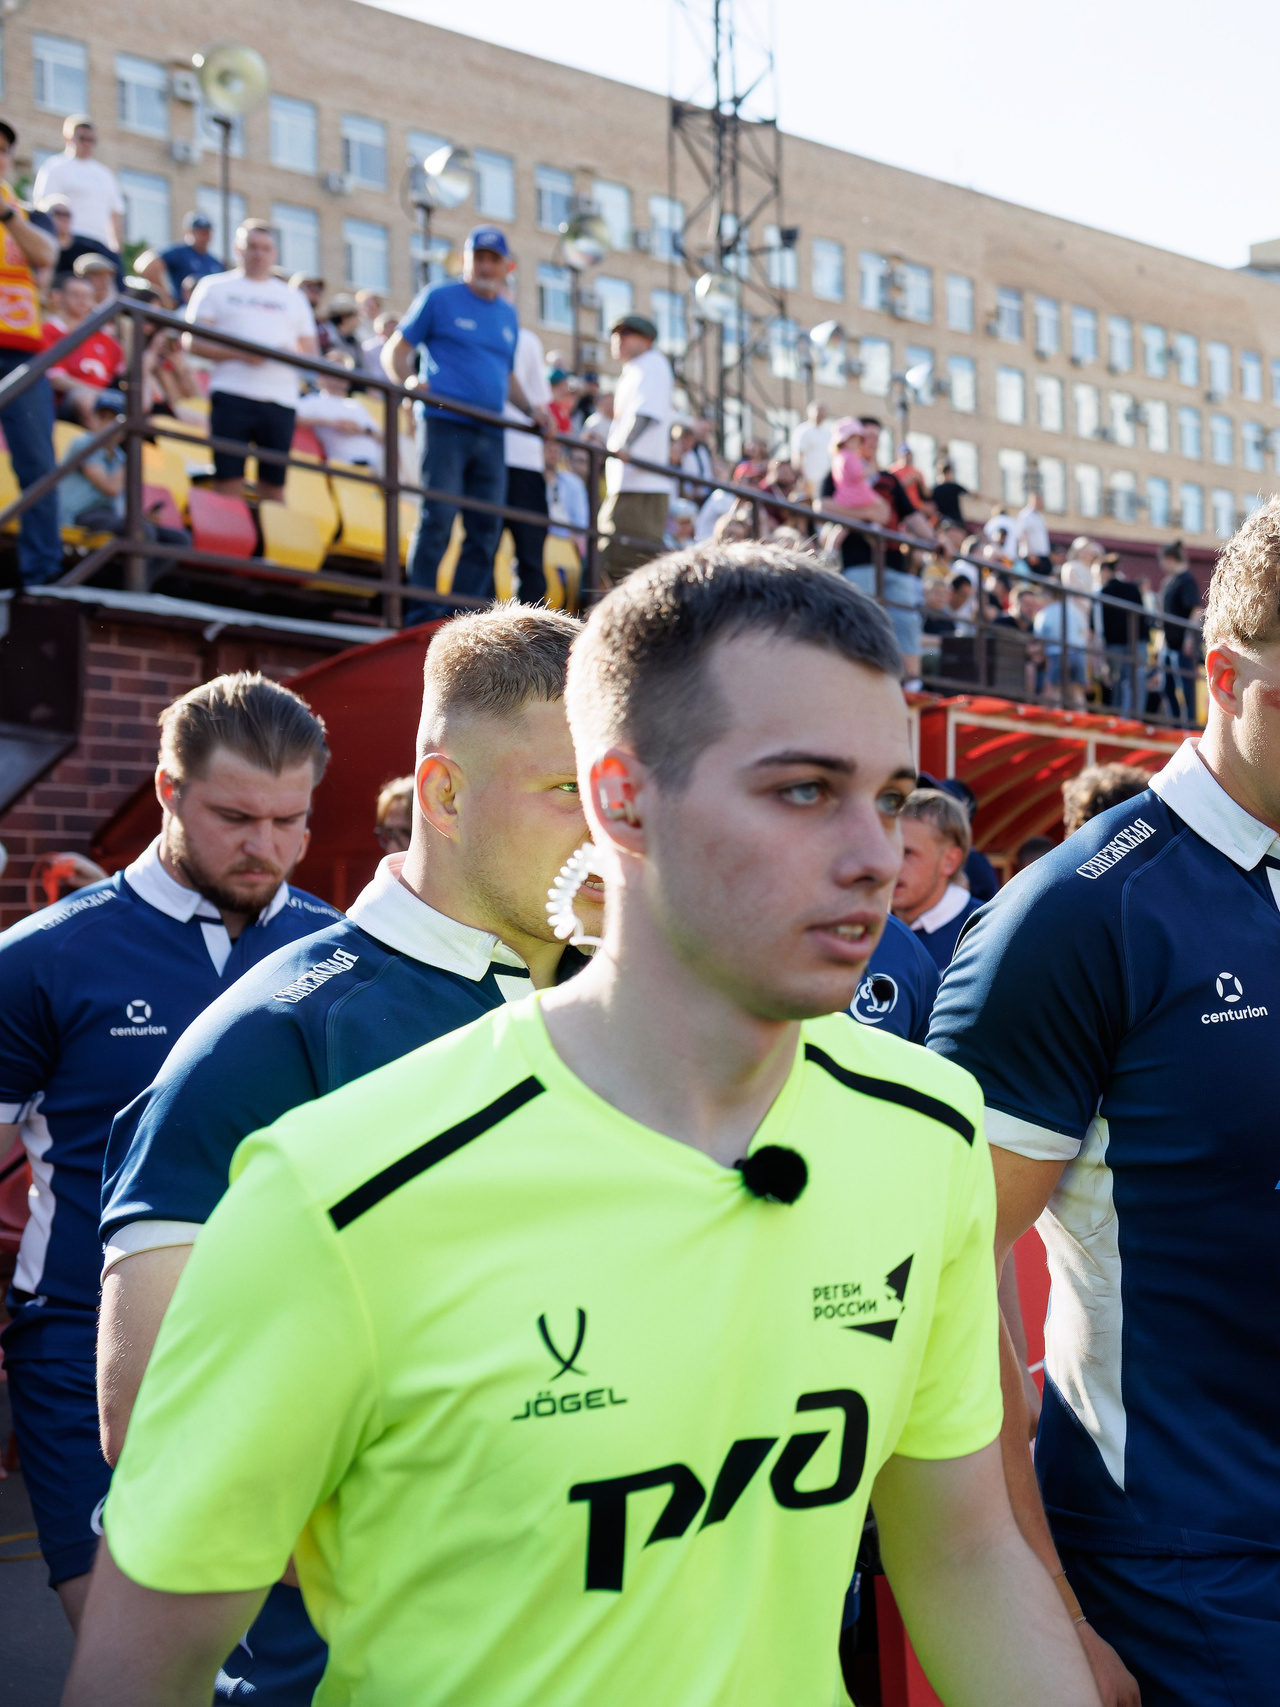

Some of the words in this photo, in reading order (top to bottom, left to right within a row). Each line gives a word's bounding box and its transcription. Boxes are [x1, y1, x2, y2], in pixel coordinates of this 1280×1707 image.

[1075, 817, 1157, 880] СЕНЕЖСКАЯ
[1201, 1004, 1269, 1025] centurion
[110, 1025, 168, 1038] centurion
[812, 1283, 863, 1302] РЕГБИ
[812, 1299, 878, 1321] РОССИИ
[511, 1387, 629, 1421] JÖGEL
